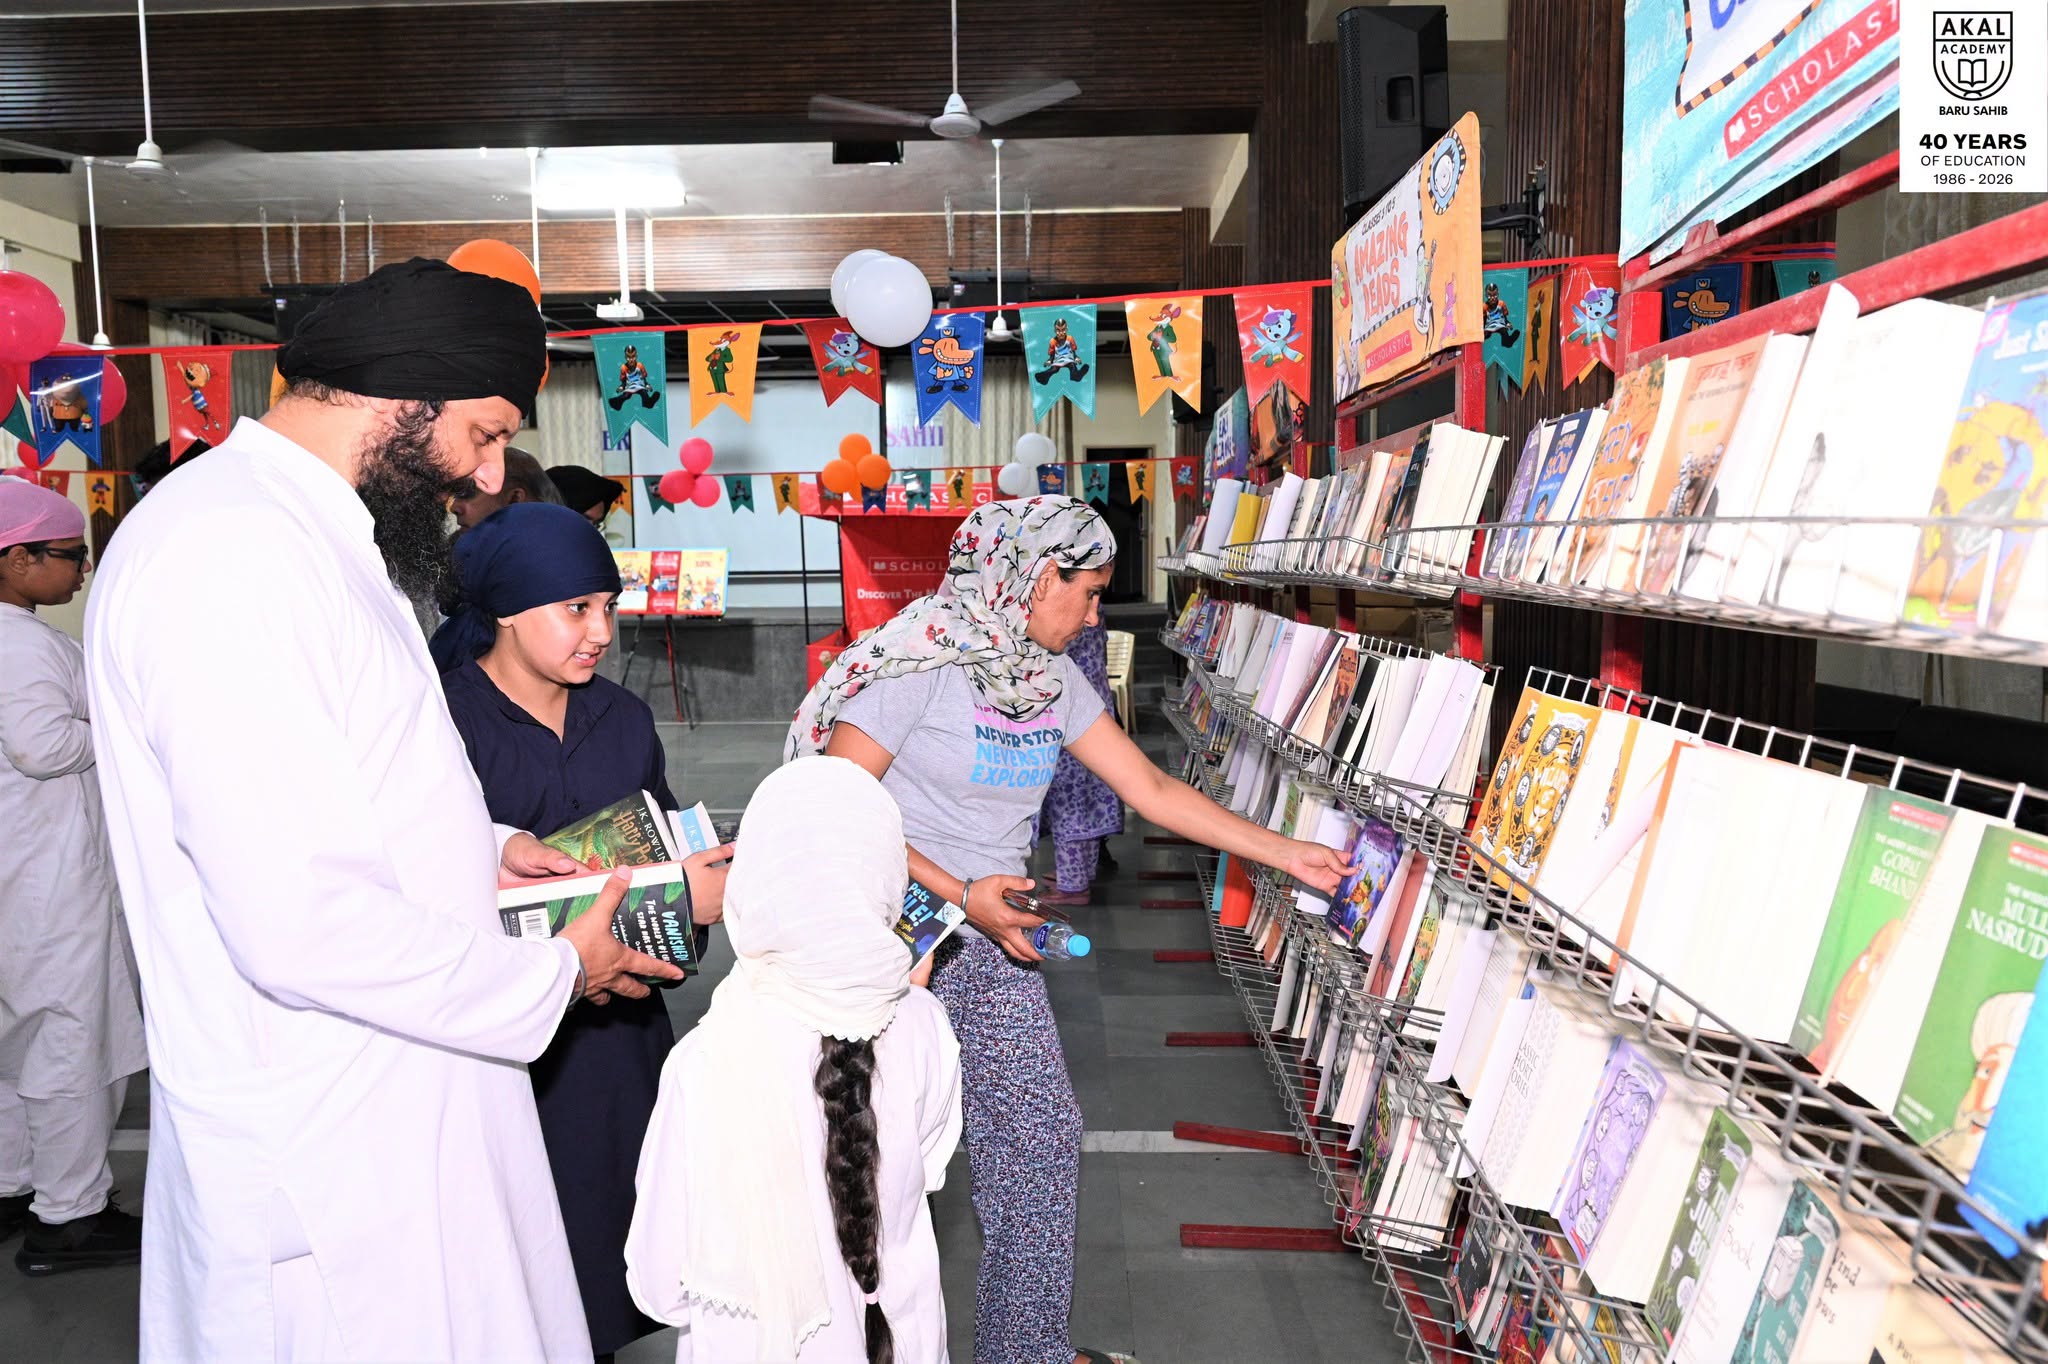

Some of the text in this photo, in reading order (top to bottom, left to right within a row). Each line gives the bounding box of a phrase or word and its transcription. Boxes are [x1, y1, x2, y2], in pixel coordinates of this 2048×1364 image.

[1354, 211, 1409, 286] AMAZING
[1363, 258, 1401, 322] READS
[1369, 334, 1411, 368] SCHOLASTIC
[613, 810, 644, 846] Harry
[1881, 849, 1922, 878] GOPAL
[645, 899, 657, 915] THE
[908, 882, 930, 903] Pets
[636, 912, 647, 929] STAR
[661, 911, 690, 962] VANISHED!
